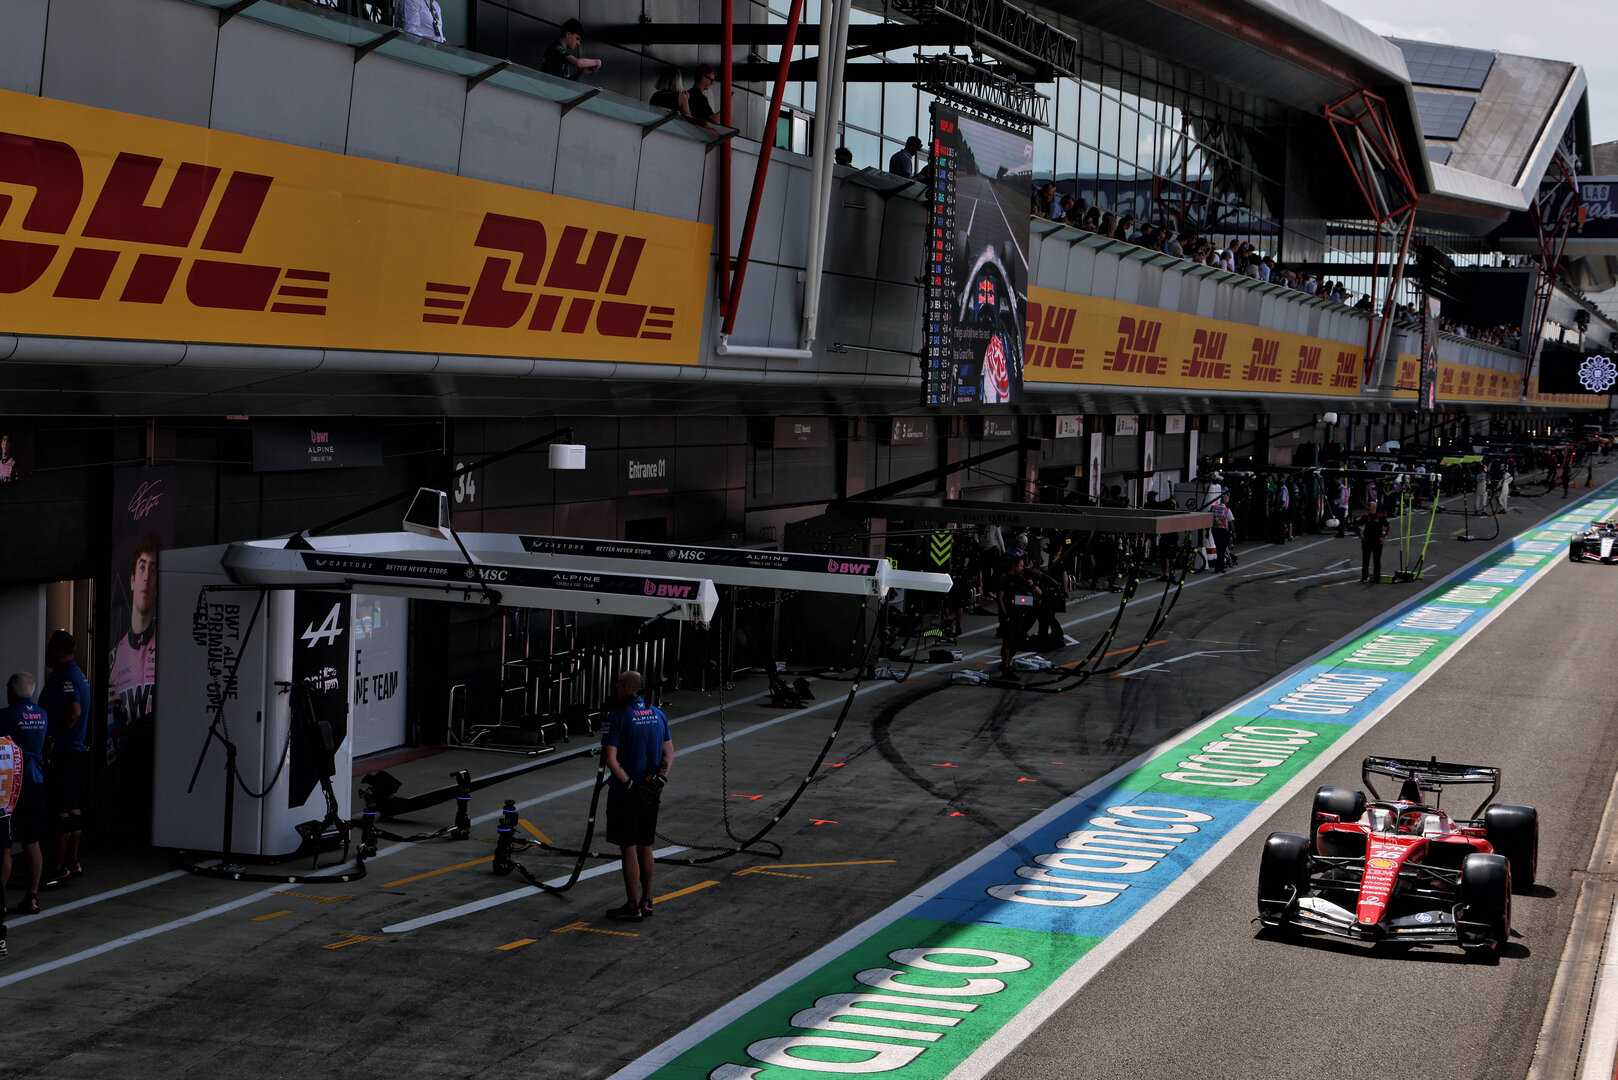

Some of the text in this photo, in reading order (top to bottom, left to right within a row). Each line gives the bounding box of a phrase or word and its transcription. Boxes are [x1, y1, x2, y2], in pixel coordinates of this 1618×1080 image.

[1584, 186, 1608, 199] LAS
[462, 213, 648, 338] DHL
[1024, 302, 1078, 369] DHL
[1112, 317, 1163, 375] DHL
[1188, 329, 1228, 380] DHL
[1248, 338, 1282, 383] DHL
[1294, 346, 1322, 385] DHL
[1334, 352, 1357, 388] DHL
[308, 446, 334, 454] ALPINE
[628, 459, 666, 479] Entrance 01
[455, 462, 476, 504] 34
[329, 559, 373, 569] CASTORE
[428, 567, 448, 575] STOPS
[478, 568, 509, 581] MSC
[553, 573, 600, 583] ALPINE
[657, 583, 691, 598] BWT
[545, 543, 585, 551] CASTORE
[677, 550, 706, 560] MSC
[745, 554, 789, 562] ALPINE
[839, 562, 871, 575] BWT
[225, 604, 240, 640] BWT
[373, 671, 398, 700] TEAM
[1268, 672, 1391, 715] aramco
[1159, 725, 1320, 787] aramco
[985, 804, 1214, 909] aramco
[1366, 869, 1395, 878] IBM
[1370, 850, 1403, 859] 16
[1417, 913, 1432, 922] hp
